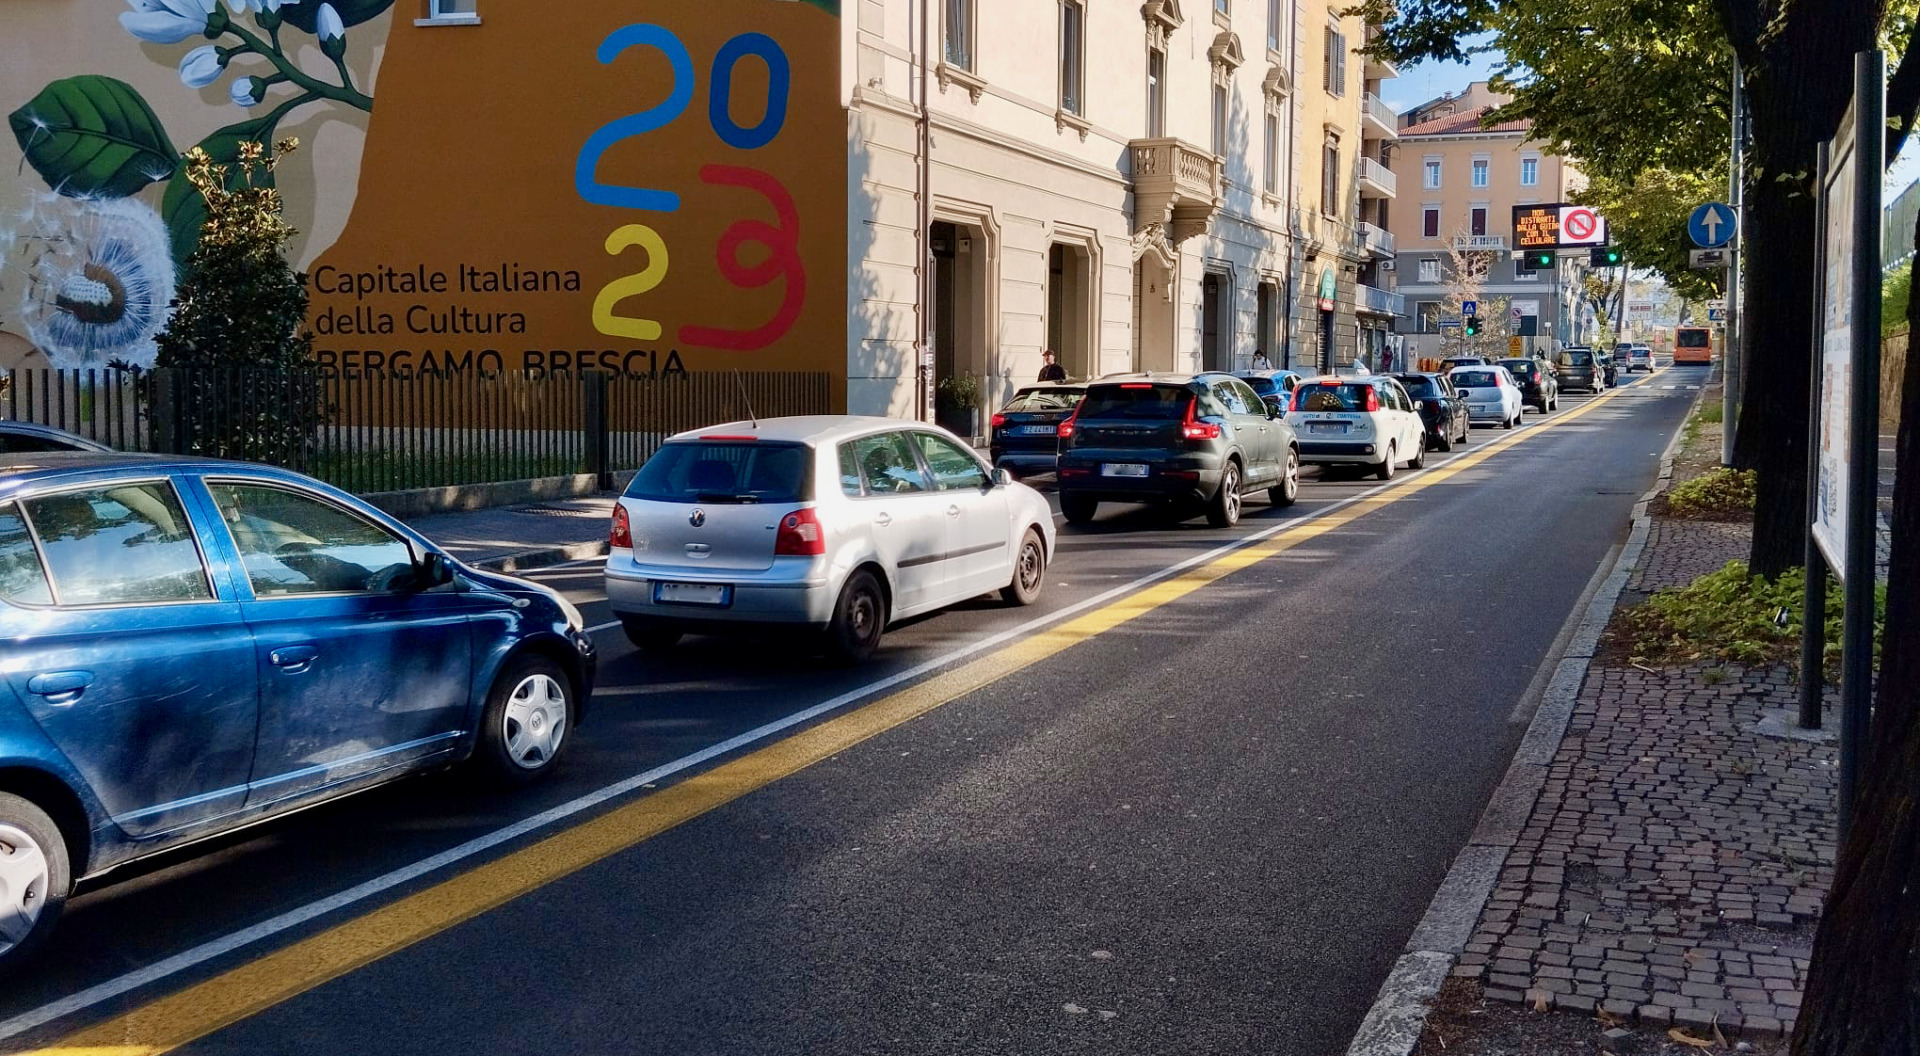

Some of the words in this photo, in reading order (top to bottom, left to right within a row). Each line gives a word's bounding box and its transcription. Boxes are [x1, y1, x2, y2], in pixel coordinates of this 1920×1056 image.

[576, 22, 790, 212] 20
[1531, 209, 1545, 217] NON
[1517, 224, 1537, 232] DALLA
[1539, 222, 1560, 230] GUIDA
[1526, 230, 1539, 238] CON
[1520, 236, 1556, 245] CELLULARE
[315, 264, 447, 300] Capitale
[459, 263, 581, 293] Italiana
[316, 305, 394, 335] della
[406, 305, 526, 335] Cultura
[317, 350, 504, 380] BERGAMO
[523, 350, 687, 380] BRESCIA
